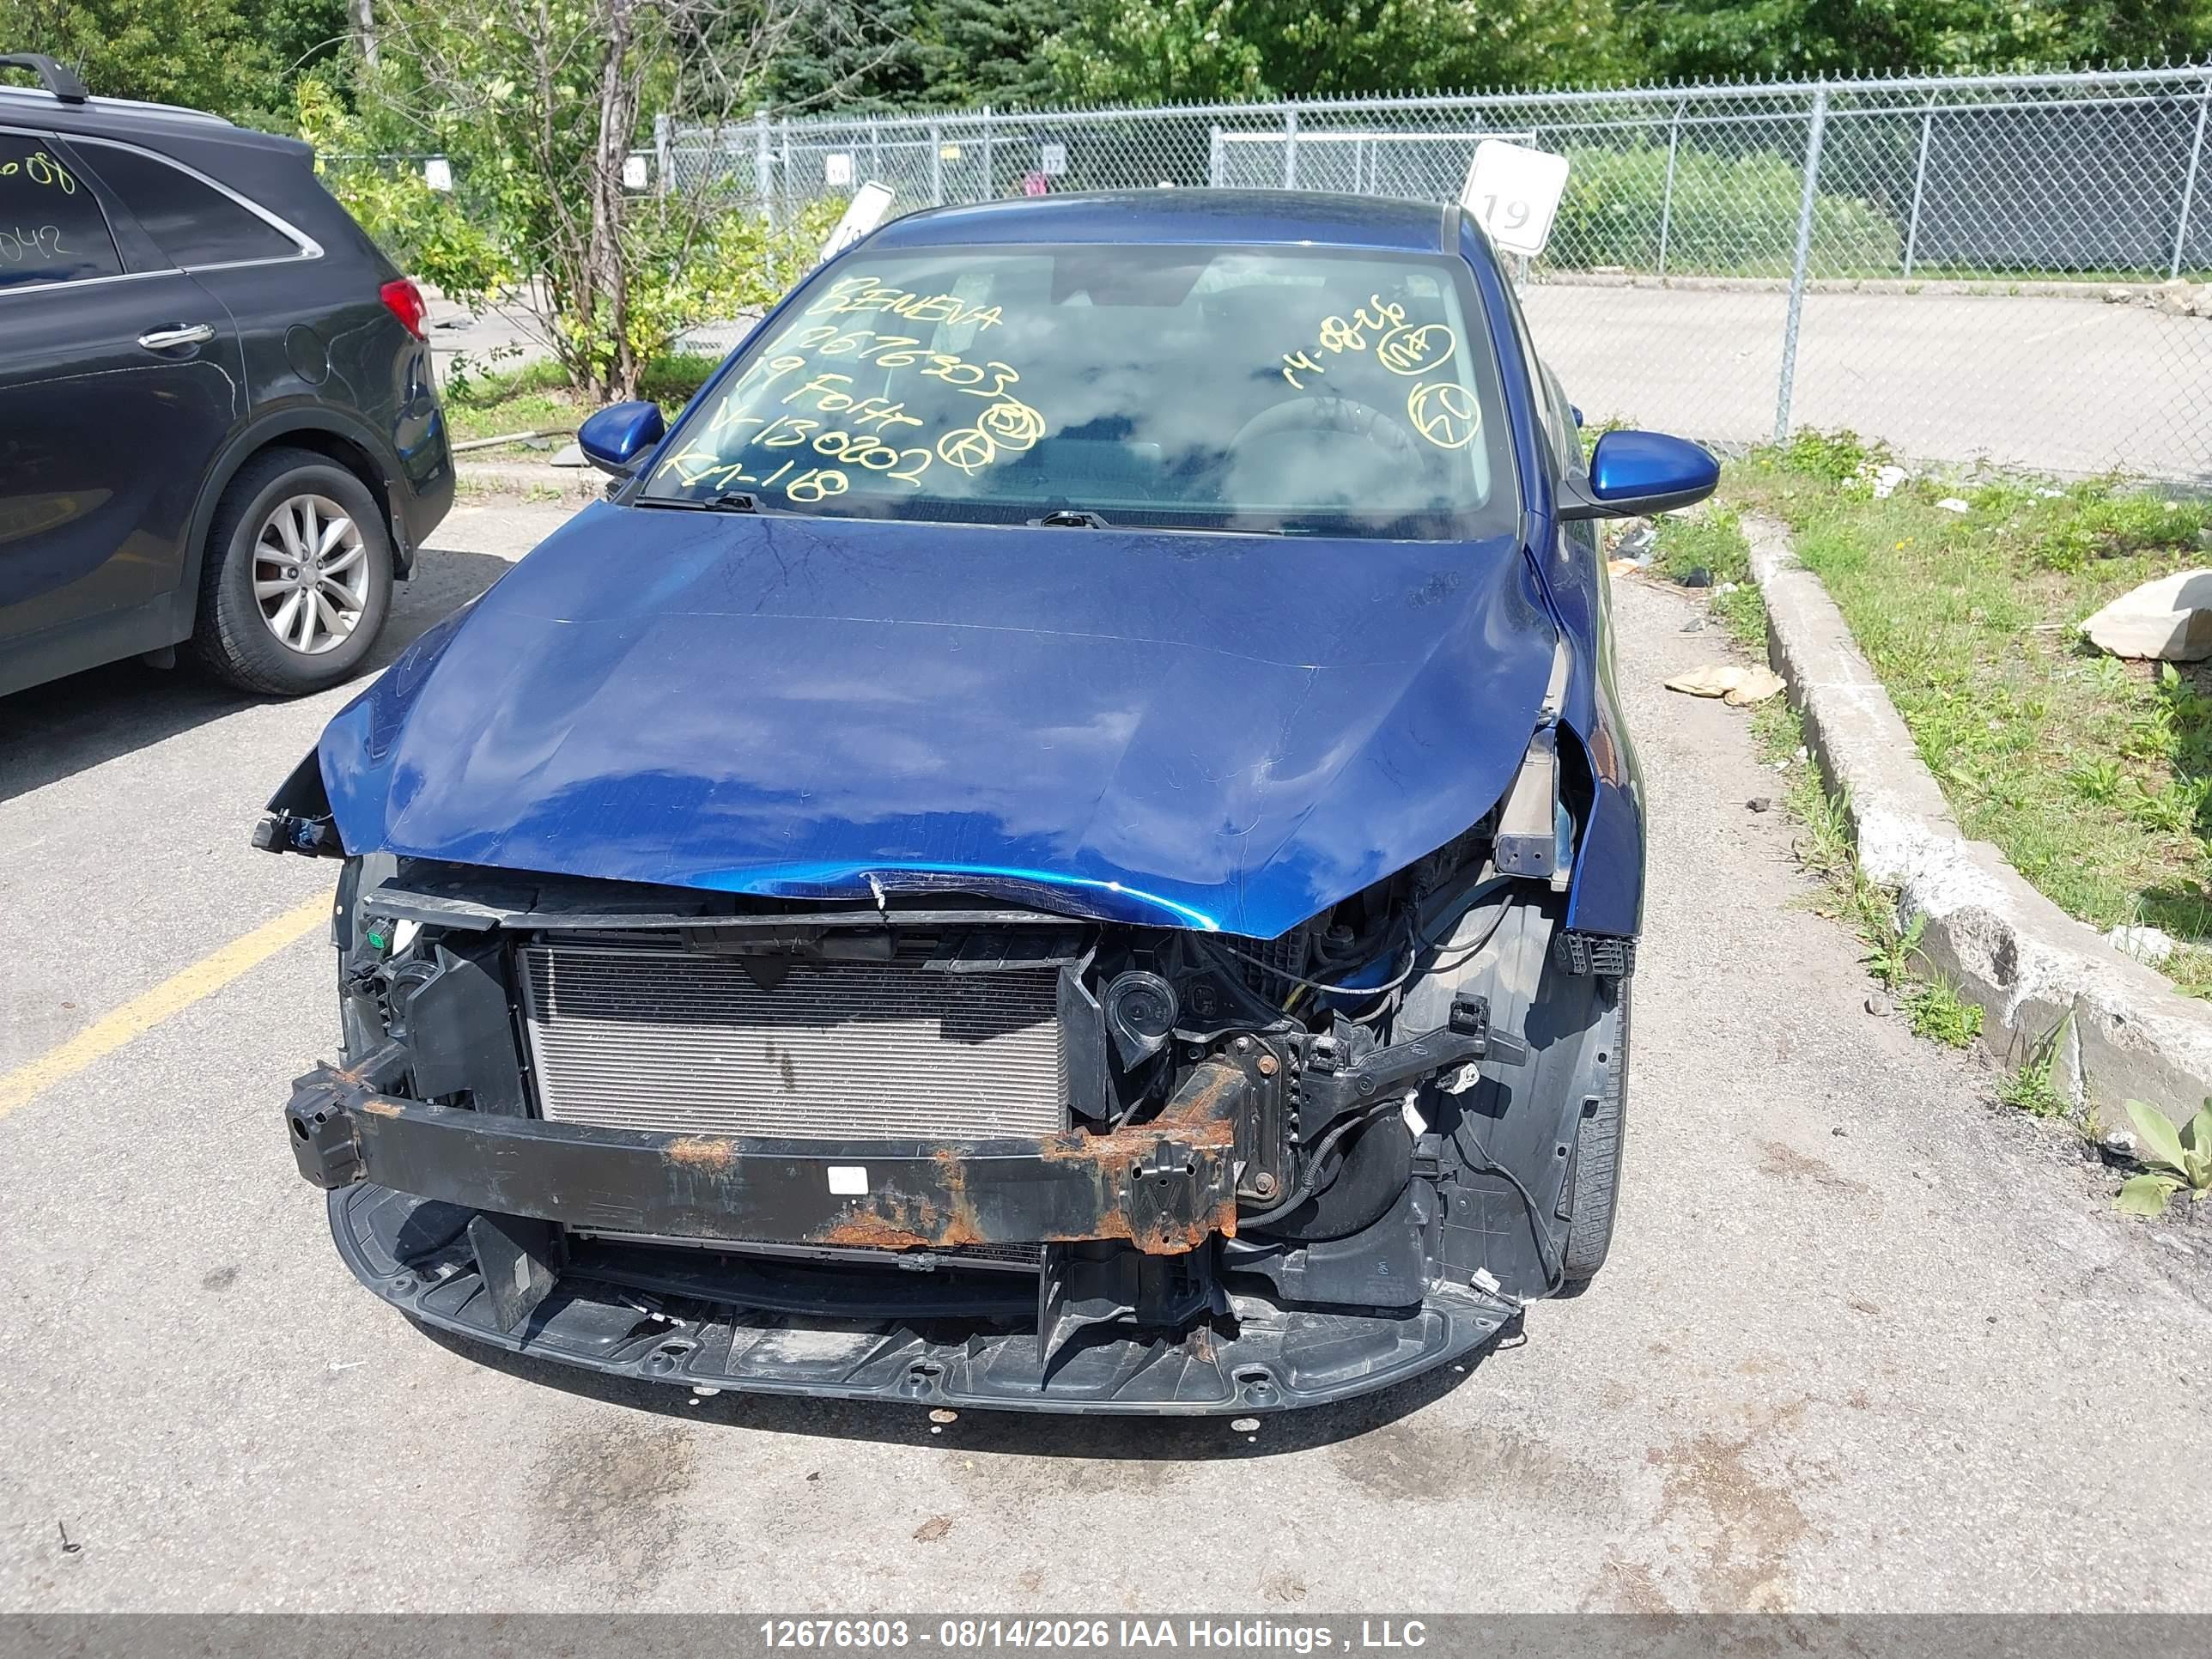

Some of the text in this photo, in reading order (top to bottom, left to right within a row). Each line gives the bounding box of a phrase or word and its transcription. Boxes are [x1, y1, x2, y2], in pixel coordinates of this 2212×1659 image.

[1483, 193, 1531, 230] 19
[736, 355, 807, 392] 19
[763, 321, 1020, 397] 12676303
